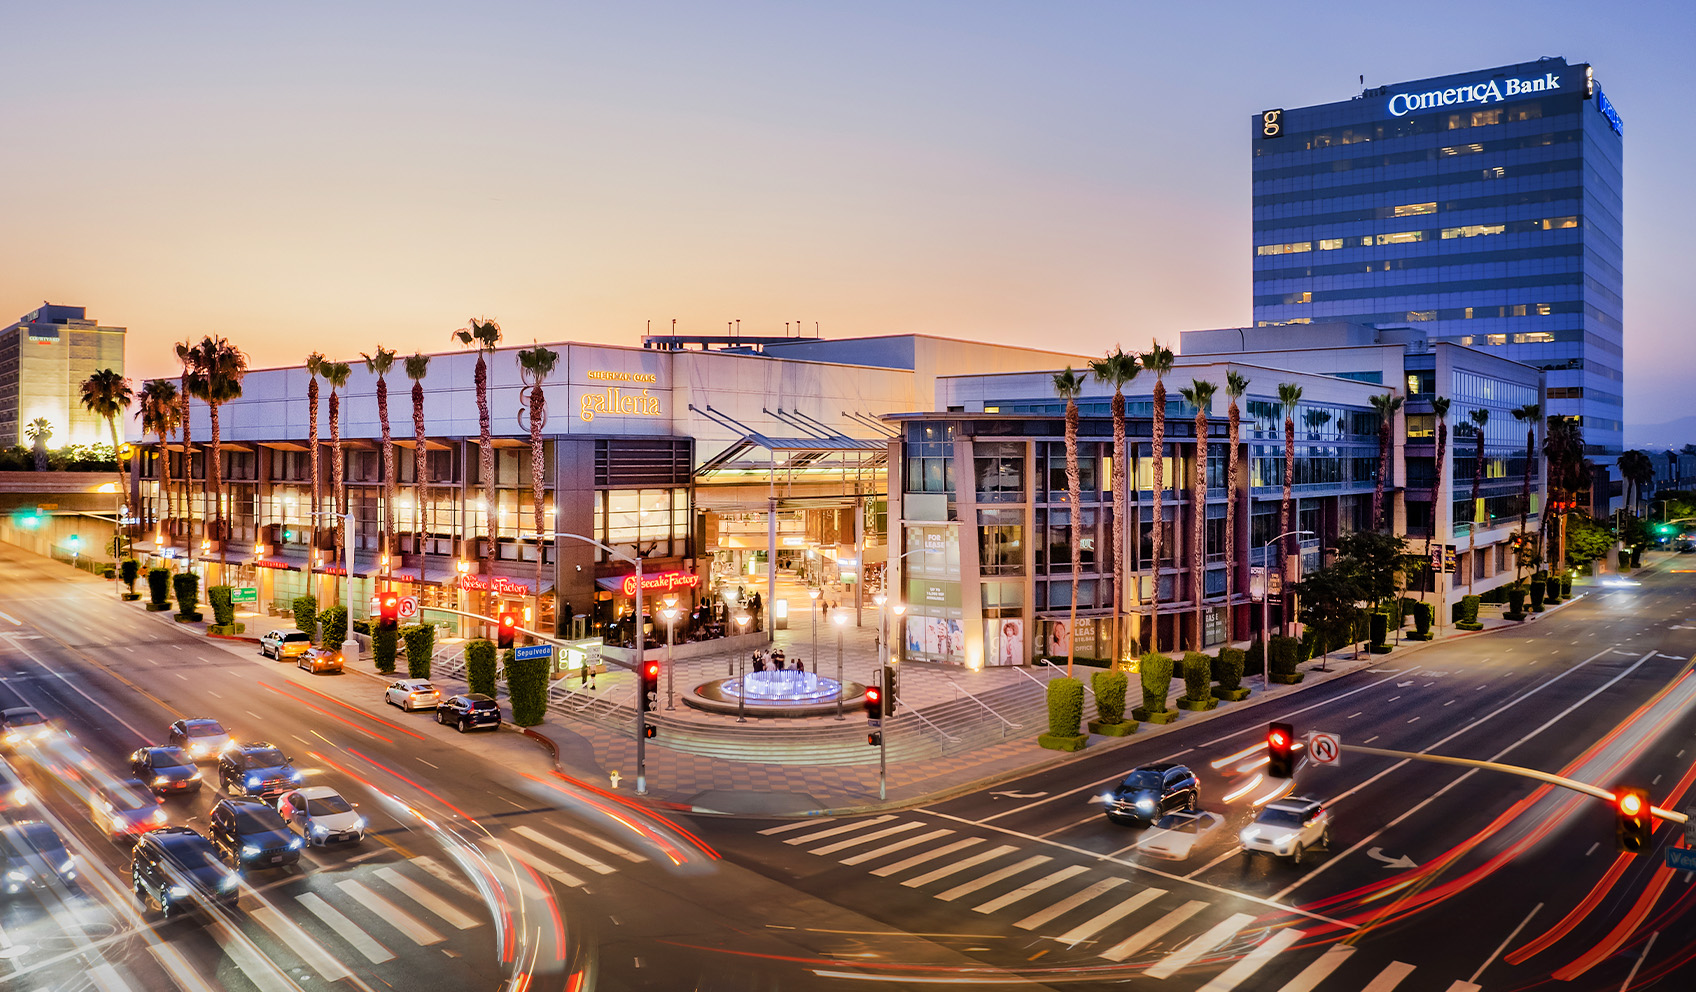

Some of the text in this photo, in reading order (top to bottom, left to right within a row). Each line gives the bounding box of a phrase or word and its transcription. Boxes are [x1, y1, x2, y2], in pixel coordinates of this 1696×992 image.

[1505, 73, 1561, 96] Bank
[1264, 110, 1280, 136] g
[587, 370, 656, 383] SHERMAN OAKS
[580, 387, 662, 422] galleria
[326, 566, 347, 575] BAKRY
[463, 576, 528, 595] Cheesecke Factory
[624, 573, 699, 595] Chesecake Factory
[1075, 618, 1090, 627] FOR
[1205, 613, 1218, 622] EASE
[517, 647, 550, 657] Sepulveda
[559, 648, 568, 669] g
